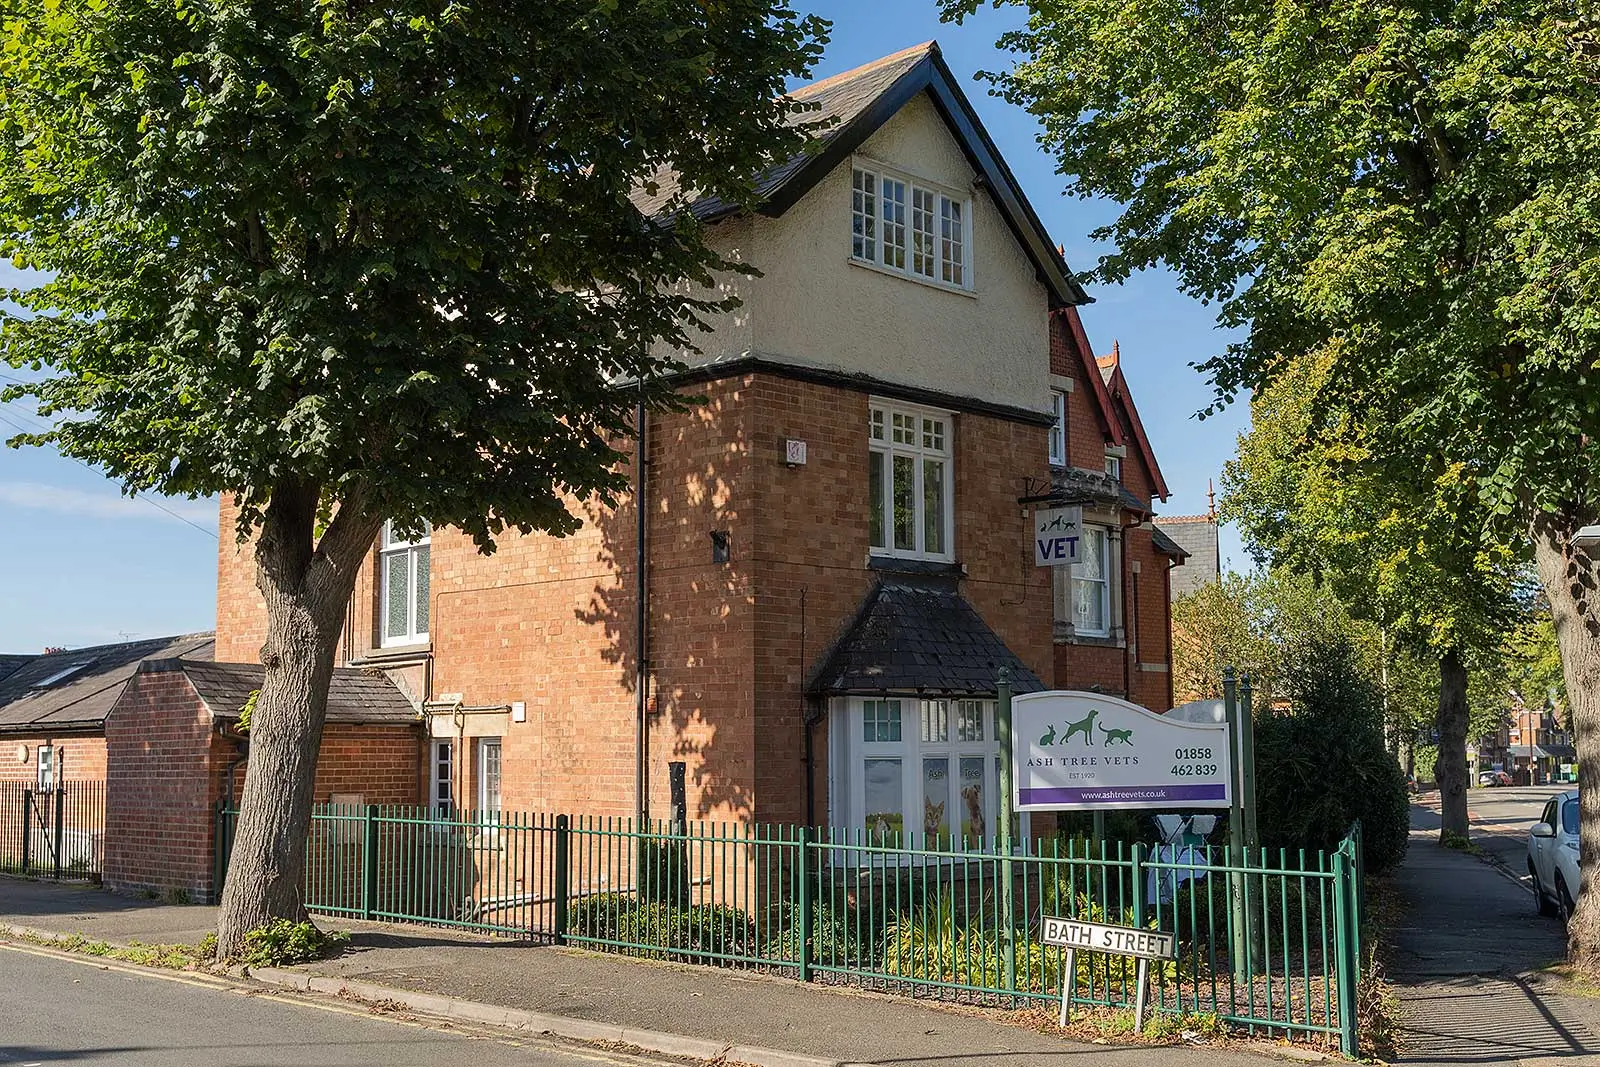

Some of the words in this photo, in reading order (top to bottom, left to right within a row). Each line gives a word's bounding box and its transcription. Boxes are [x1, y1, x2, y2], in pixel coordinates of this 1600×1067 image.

[1037, 536, 1080, 560] VET
[1175, 748, 1212, 760] 01858
[1027, 758, 1053, 767] ASH
[1061, 757, 1098, 766] TREE
[1104, 756, 1140, 765] VETS
[928, 768, 943, 777] Ash
[965, 768, 980, 777] Tree
[1170, 764, 1195, 776] 462
[1195, 764, 1217, 776] 839
[1081, 789, 1166, 800] www.ashtreevets.co.uk
[1048, 922, 1092, 944] BATH
[1103, 930, 1169, 955] STREET
